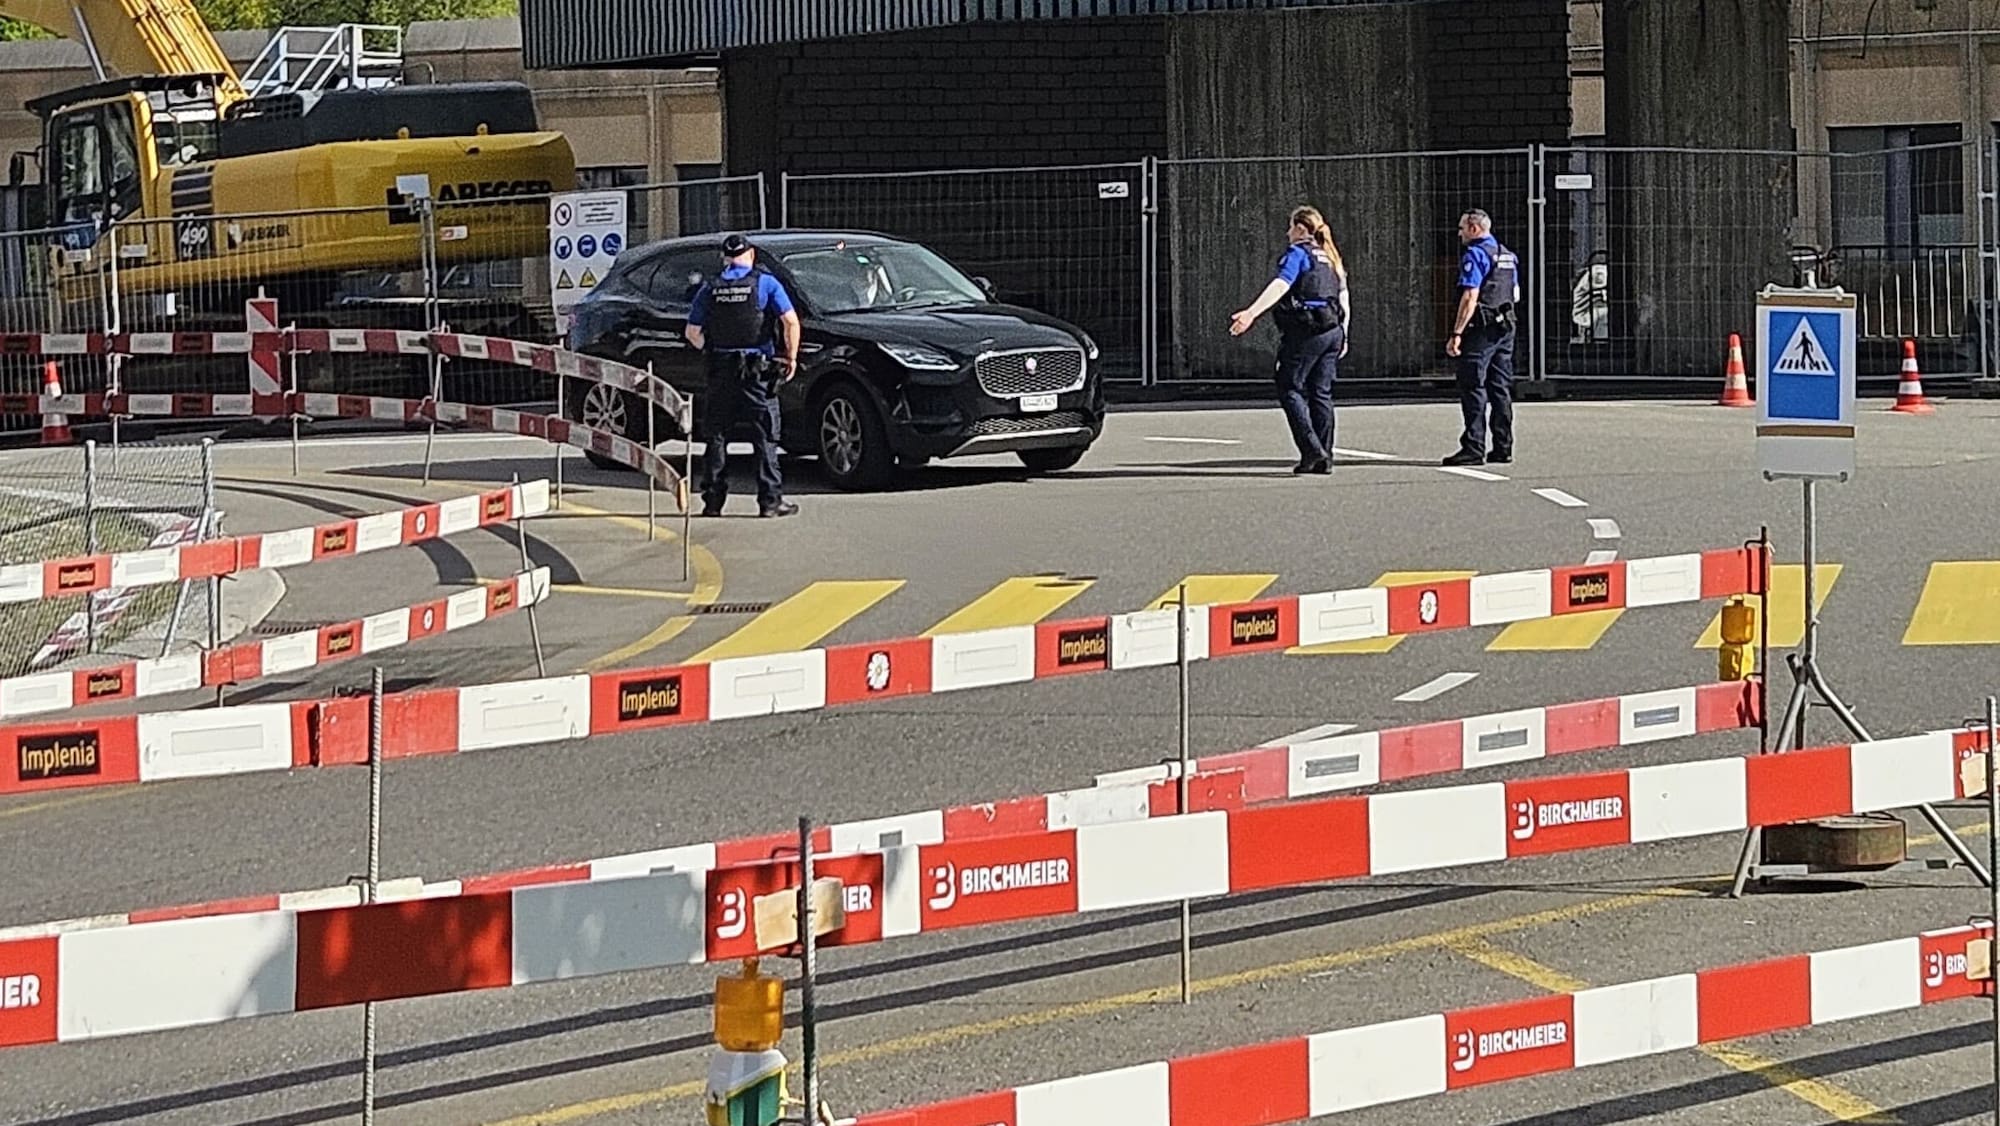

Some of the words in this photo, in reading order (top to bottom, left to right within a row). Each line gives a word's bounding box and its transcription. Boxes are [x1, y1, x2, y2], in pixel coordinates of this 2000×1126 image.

[180, 226, 208, 245] 490
[1571, 578, 1607, 602] Implenia
[1233, 615, 1276, 639] Implenia
[1061, 634, 1106, 661] Implenia
[622, 684, 679, 717] Implenia
[22, 740, 96, 776] Implenia
[1539, 796, 1622, 827] BIRCHMEIER
[961, 858, 1069, 895] BIRCHMEIER
[1945, 953, 1968, 975] BIR
[1479, 1021, 1567, 1058] BIRCHMEIER
